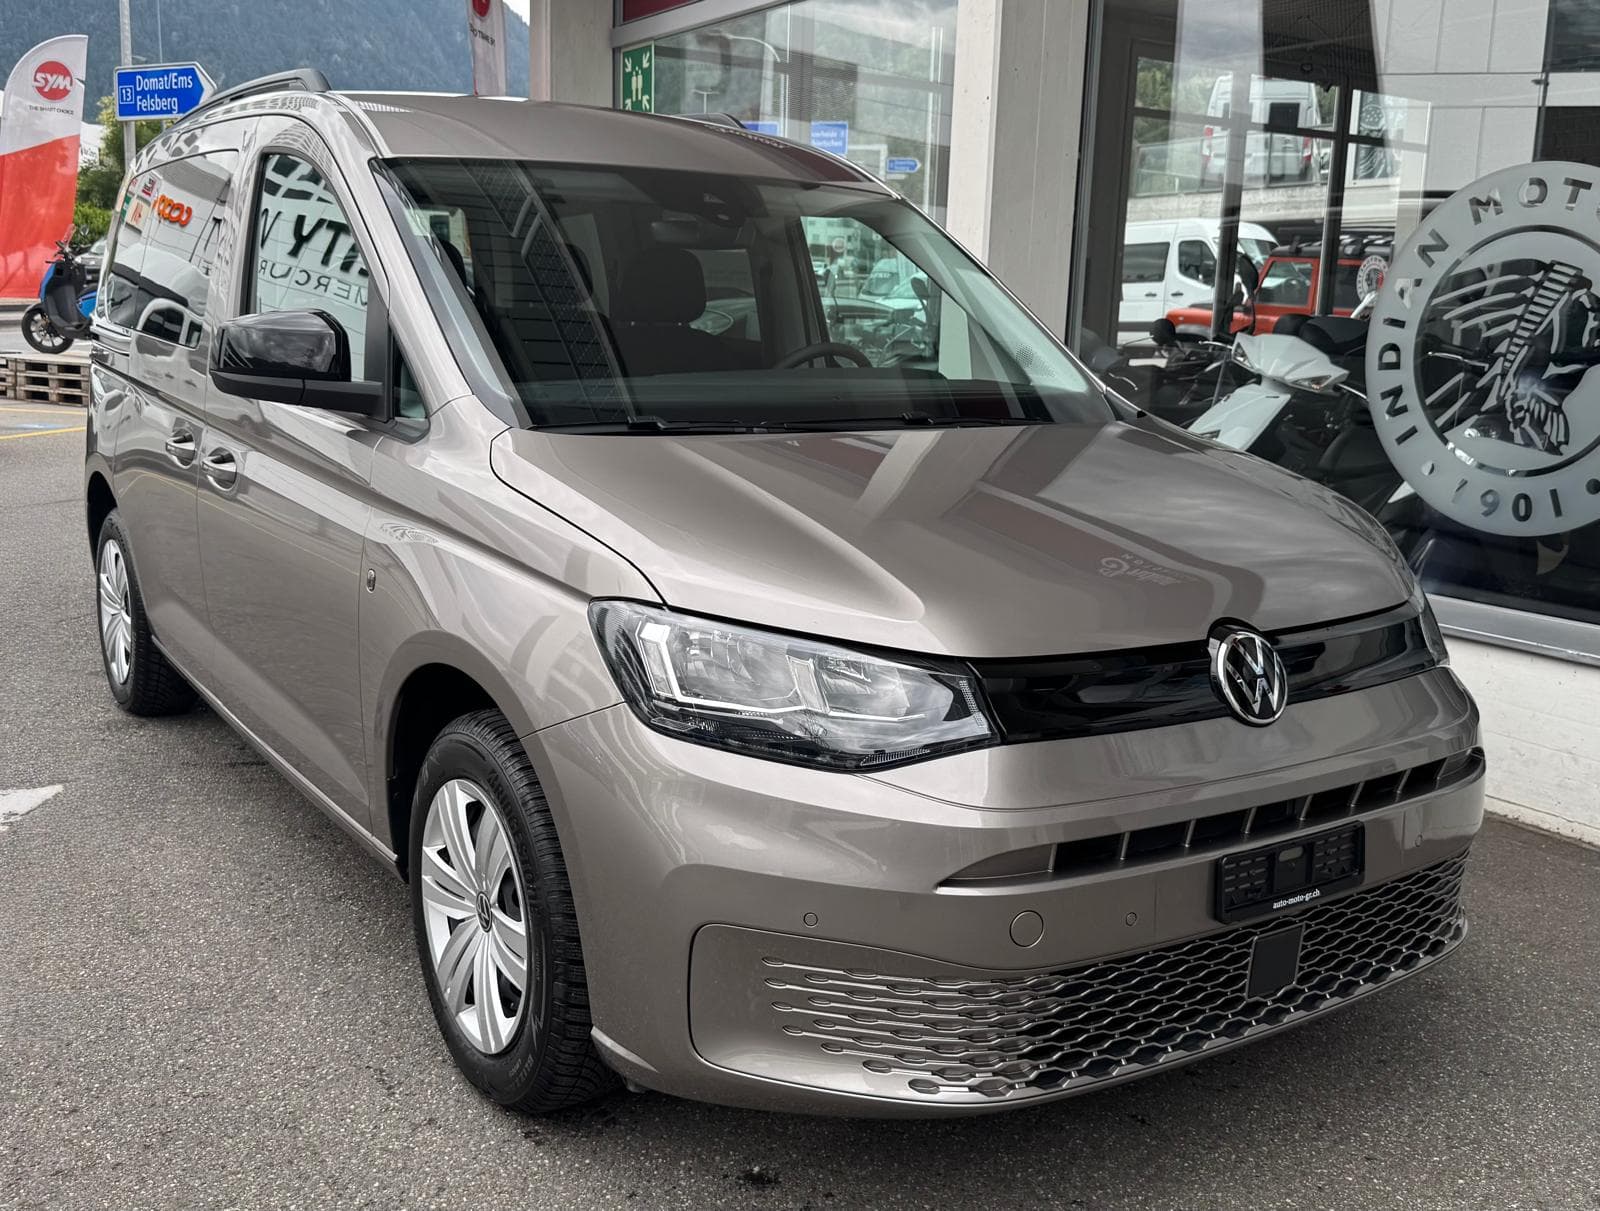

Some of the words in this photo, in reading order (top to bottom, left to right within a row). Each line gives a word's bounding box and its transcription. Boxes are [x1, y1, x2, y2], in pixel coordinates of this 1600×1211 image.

[33, 72, 73, 92] SYM
[135, 72, 193, 92] Domat/Ems
[122, 88, 132, 102] 13
[136, 93, 178, 114] Felsberg
[1468, 177, 1600, 226] MOT
[1377, 228, 1450, 446] INDIAN
[1452, 478, 1563, 523] 1901
[1272, 888, 1321, 909] auto-moto-gr.ch
